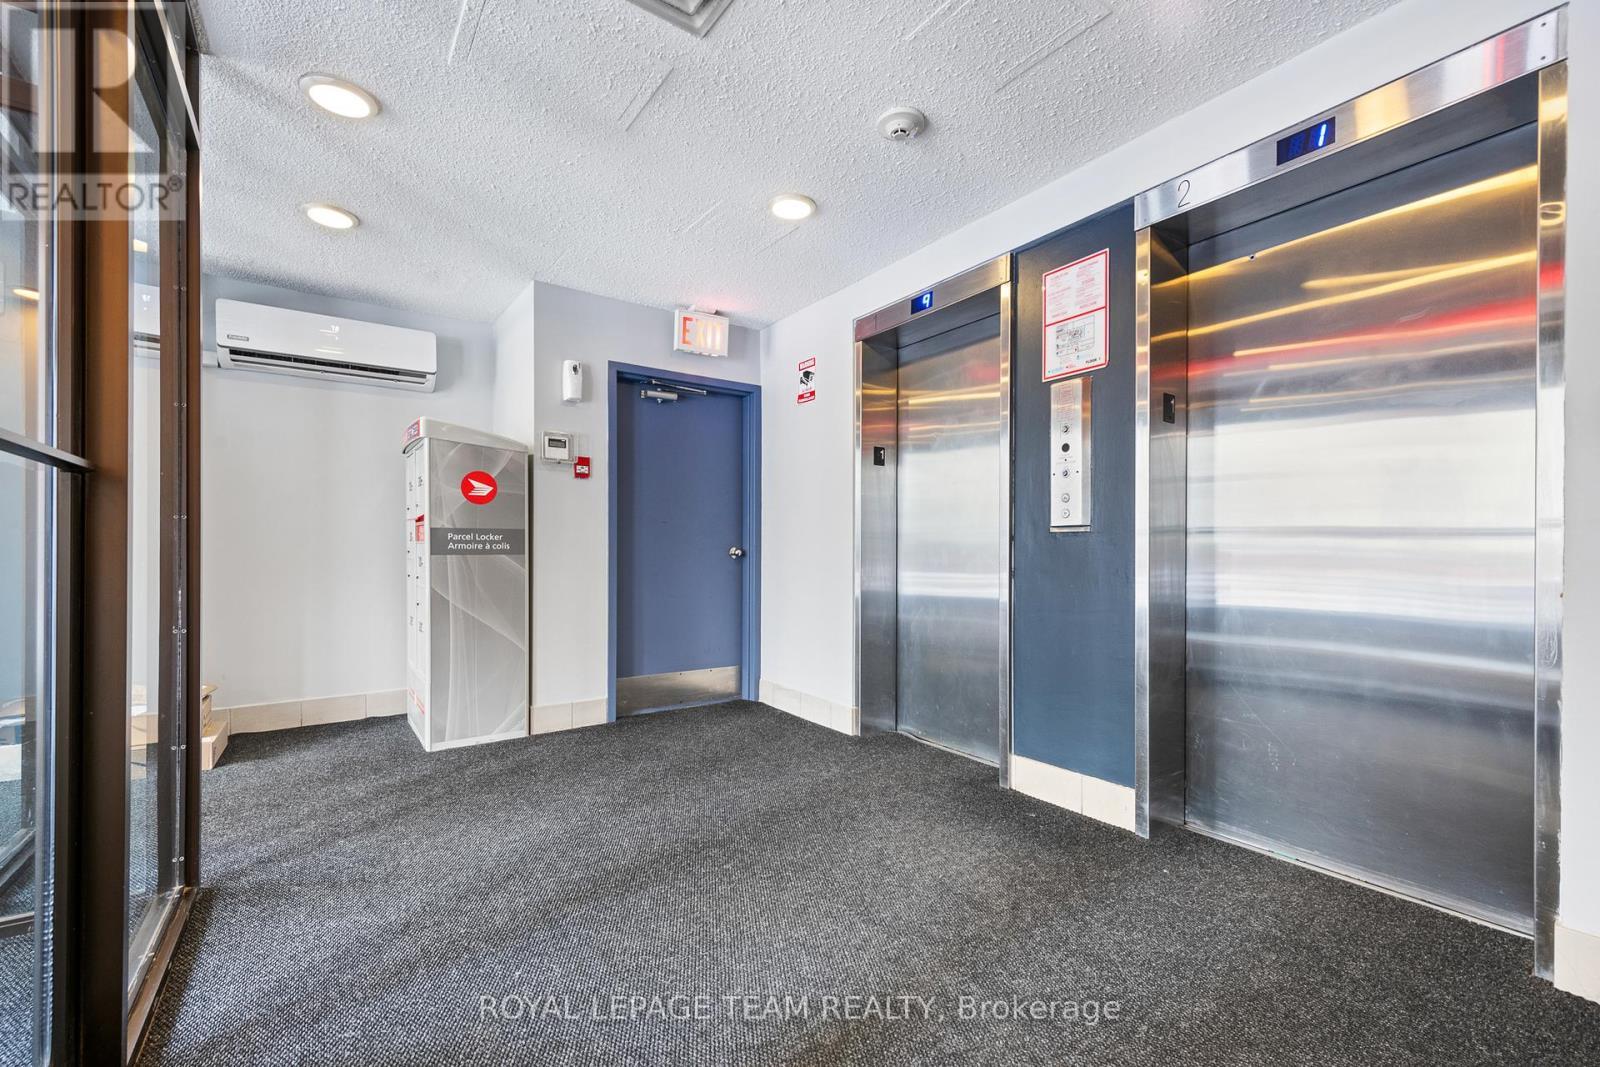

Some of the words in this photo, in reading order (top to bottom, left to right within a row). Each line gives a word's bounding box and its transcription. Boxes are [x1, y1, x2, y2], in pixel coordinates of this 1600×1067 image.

[1177, 179, 1191, 209] 2
[922, 293, 931, 308] 9
[682, 316, 724, 351] EXIT
[447, 532, 474, 541] Parcel
[475, 533, 503, 541] Locker
[447, 542, 483, 550] Armoire
[485, 542, 491, 550] à
[492, 542, 510, 550] colis
